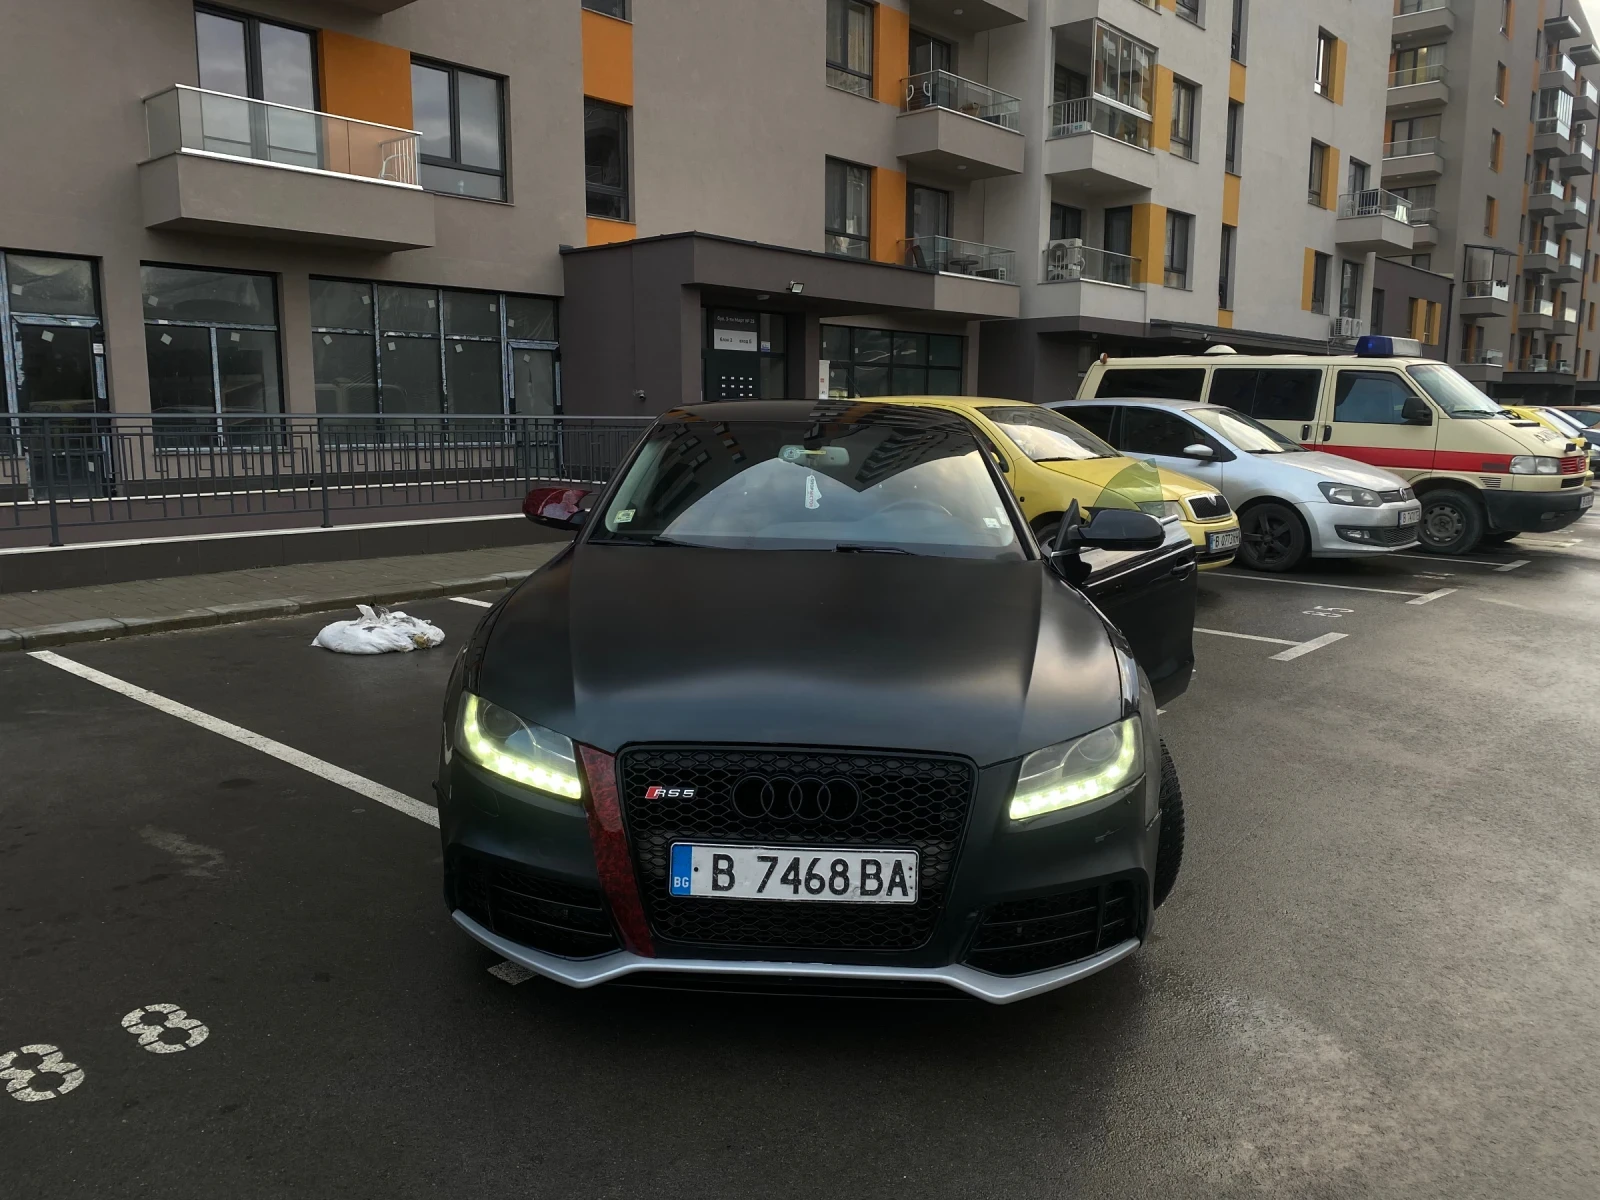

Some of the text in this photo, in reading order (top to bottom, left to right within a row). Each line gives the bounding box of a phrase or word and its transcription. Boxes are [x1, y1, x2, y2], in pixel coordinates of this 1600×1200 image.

[673, 876, 690, 889] BG
[711, 853, 909, 897] B 7468 BA
